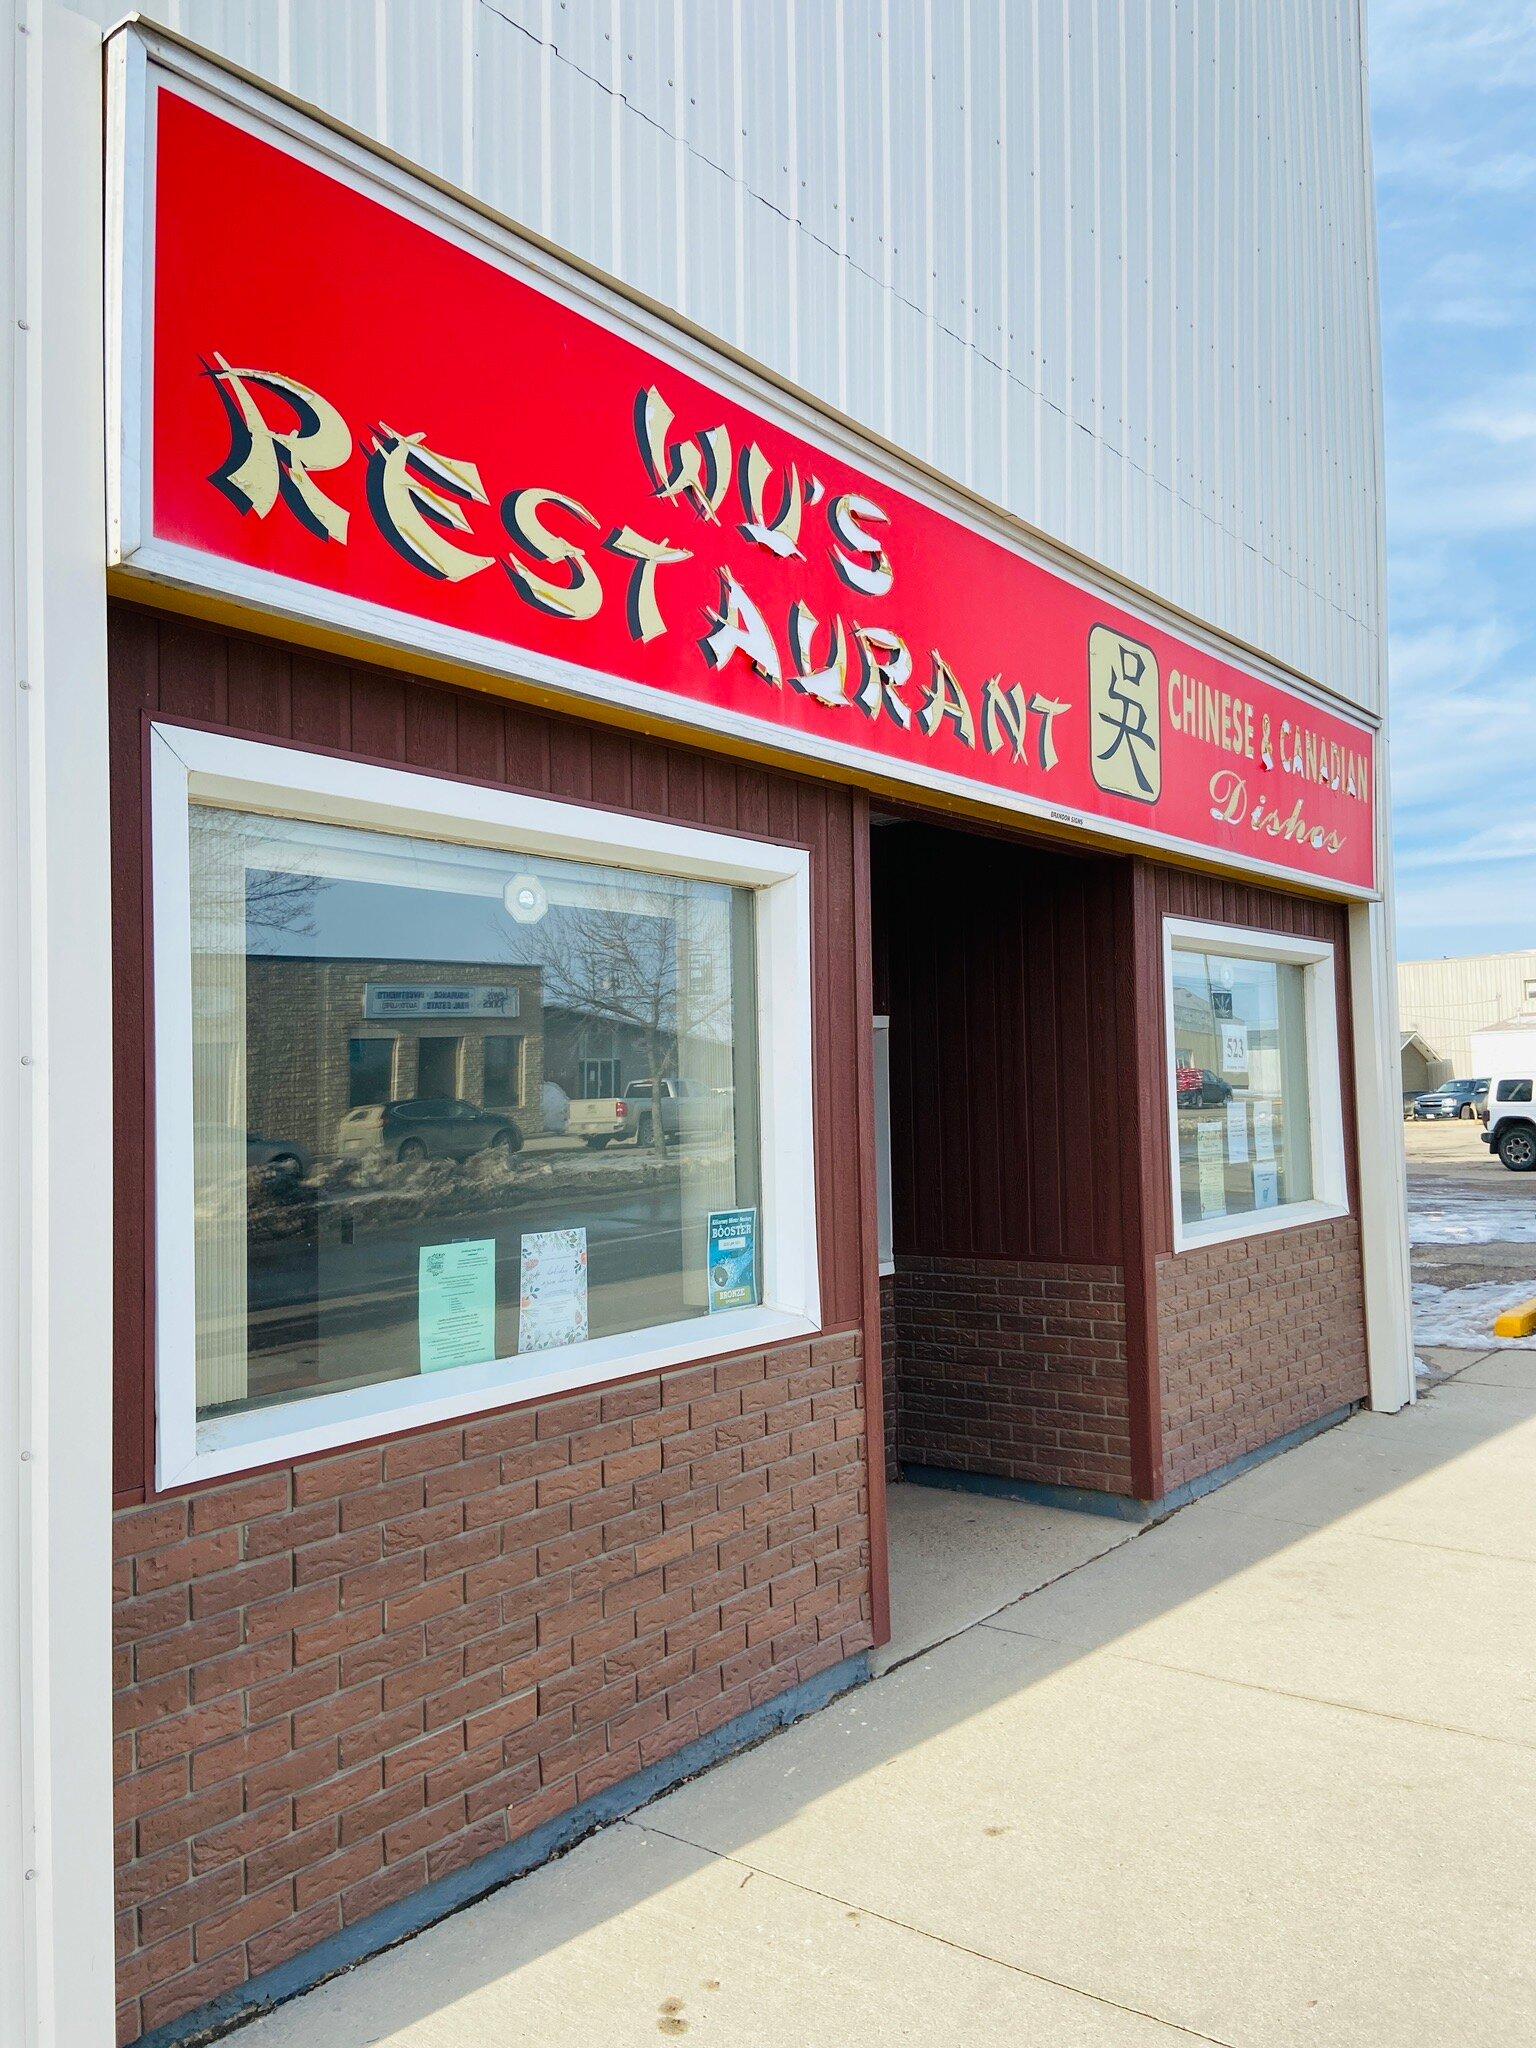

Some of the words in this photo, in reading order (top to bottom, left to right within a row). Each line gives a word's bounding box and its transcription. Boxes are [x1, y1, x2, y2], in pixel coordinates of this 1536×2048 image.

[633, 384, 894, 597] WU'S
[198, 350, 1073, 772] RESTAURANT
[1168, 669, 1254, 760] CHINESE
[1260, 713, 1275, 772] &
[1279, 719, 1369, 804] CANADIAN
[1050, 810, 1071, 821] BRANDON
[1209, 769, 1347, 854] Dishes
[1226, 1038, 1244, 1058] 523
[712, 1223, 752, 1238] BOOSTER
